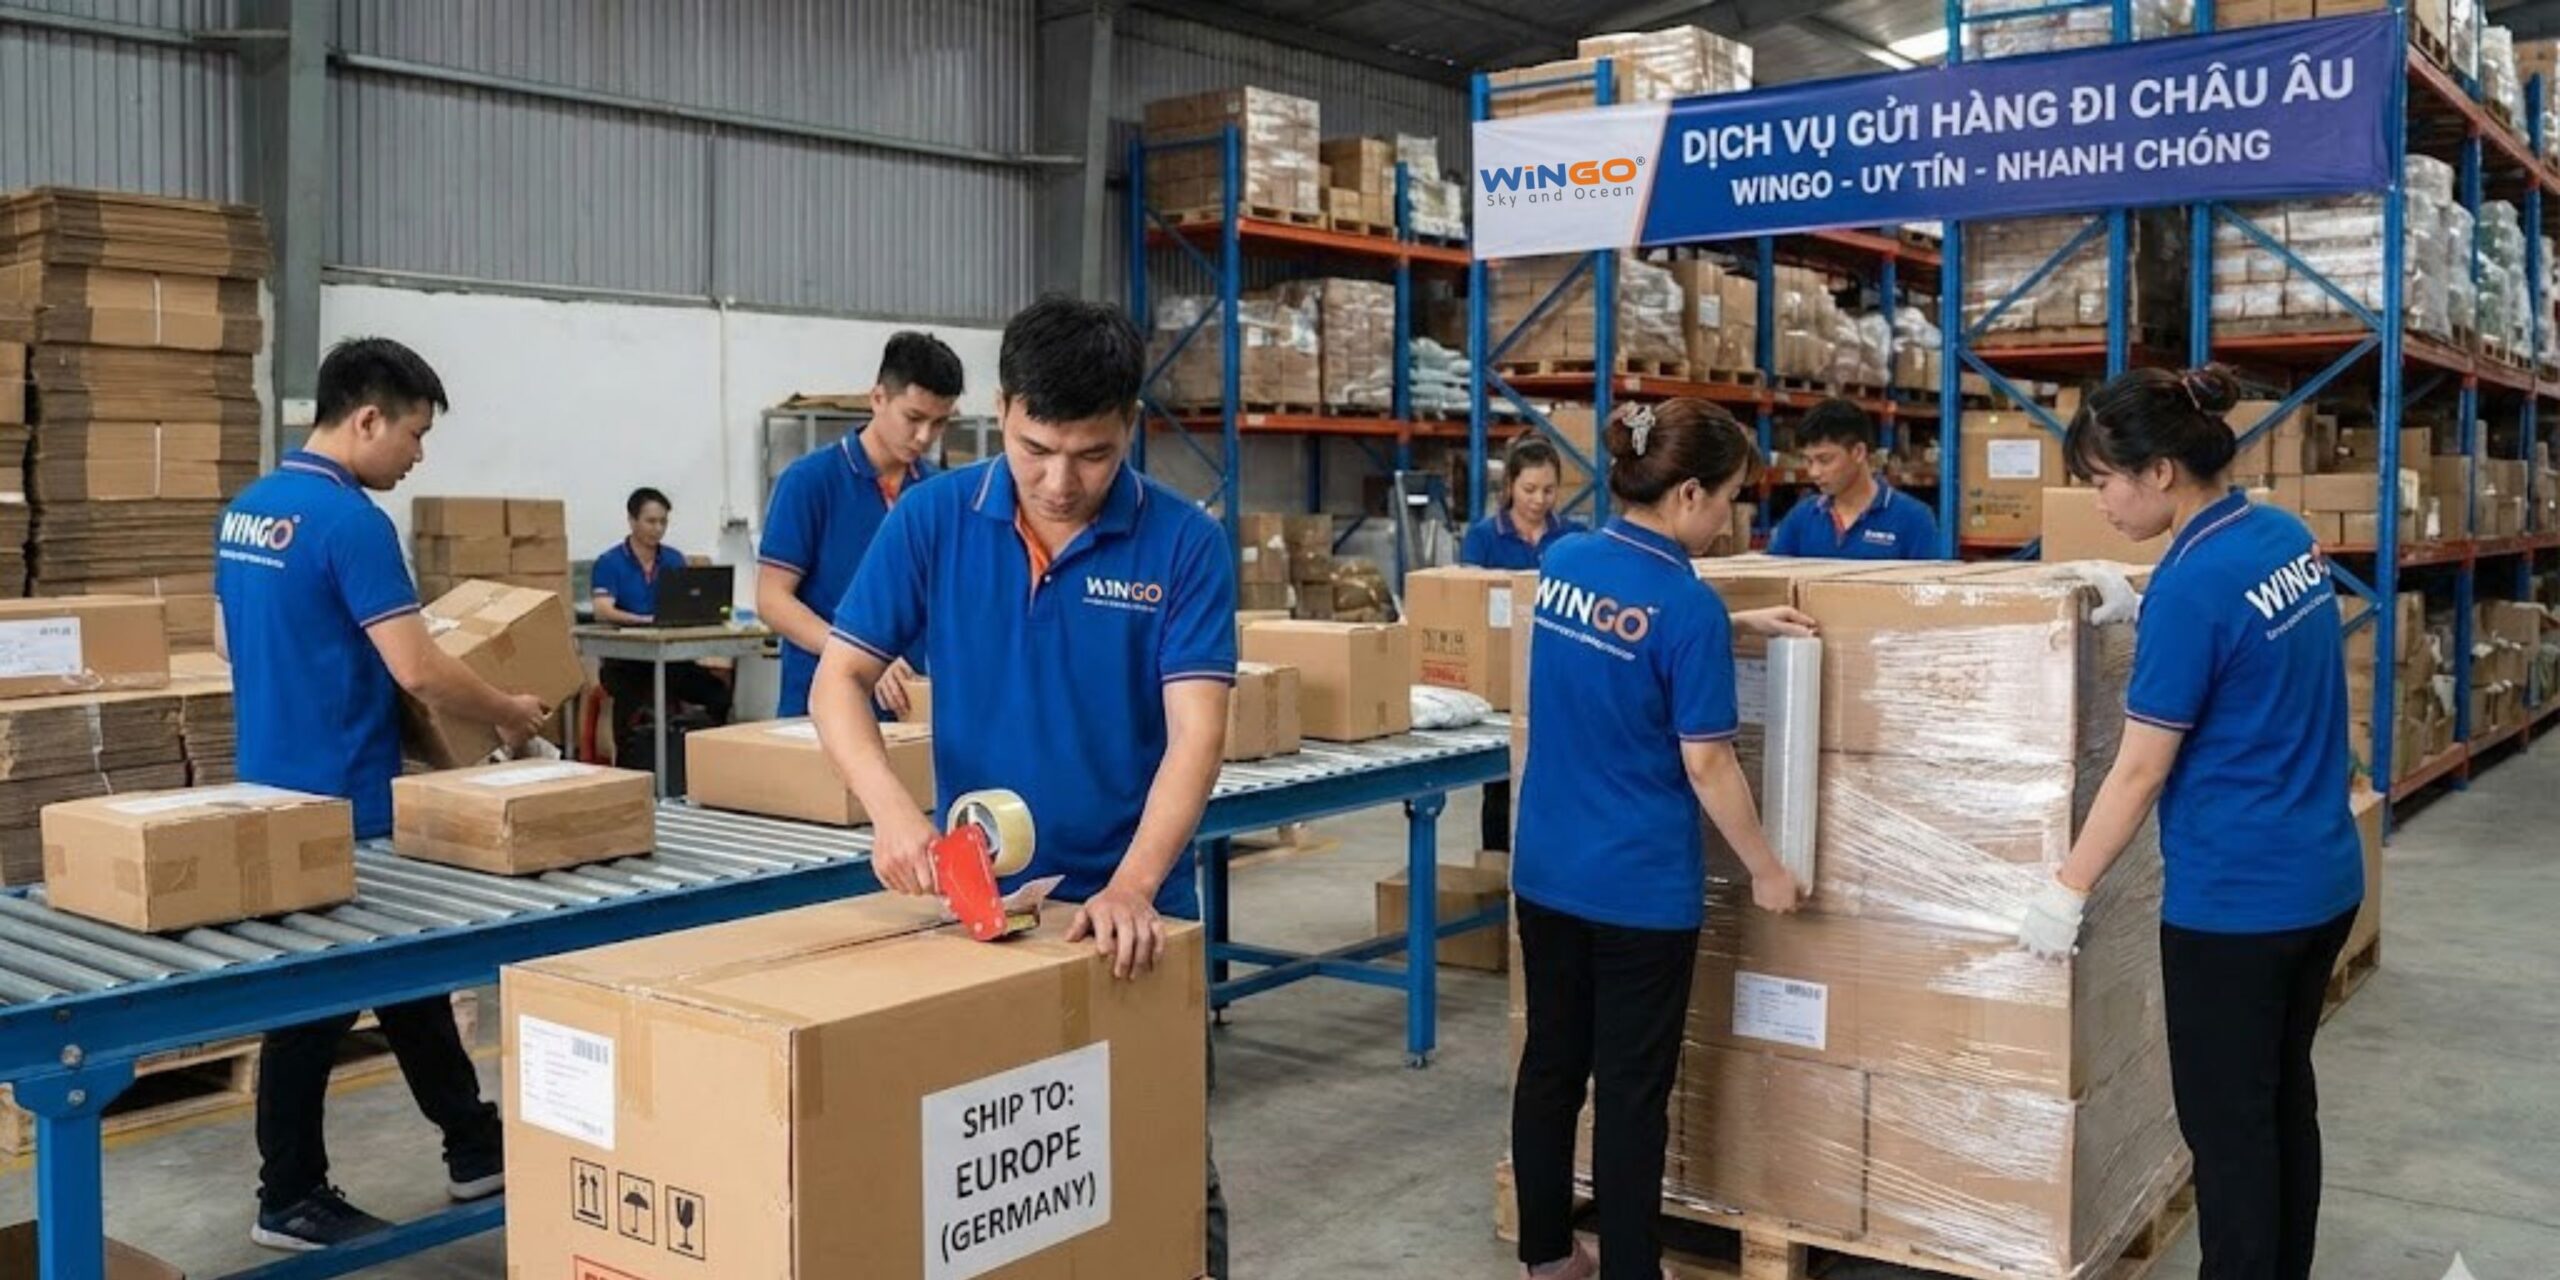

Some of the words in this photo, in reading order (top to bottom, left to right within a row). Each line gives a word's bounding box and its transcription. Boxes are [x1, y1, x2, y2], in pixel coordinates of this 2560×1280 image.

[1682, 122, 1772, 170] DỊCH
[1782, 114, 1836, 158] VỤ
[1847, 94, 1919, 148] GỬI
[1932, 89, 2058, 138] HÀNG
[2069, 83, 2116, 126] ĐI
[2130, 61, 2269, 120] CHÂU
[2282, 52, 2354, 104] ÂU
[1487, 194, 1517, 208] Sky
[1529, 189, 1563, 203] and
[1574, 186, 1635, 200] Ocean
[1731, 170, 1833, 206] WINGO
[1861, 162, 1904, 194] UY
[1911, 152, 1966, 189] TÍN
[1996, 142, 2124, 182] NHANH
[2133, 128, 2272, 171] CHÓNG
[1087, 576, 1163, 603] WINGO
[963, 1093, 1024, 1139] SHIP
[1030, 1081, 1075, 1115] TO:
[956, 1124, 1081, 1200] EUROPE
[941, 1171, 1096, 1264] (GERMANY)
